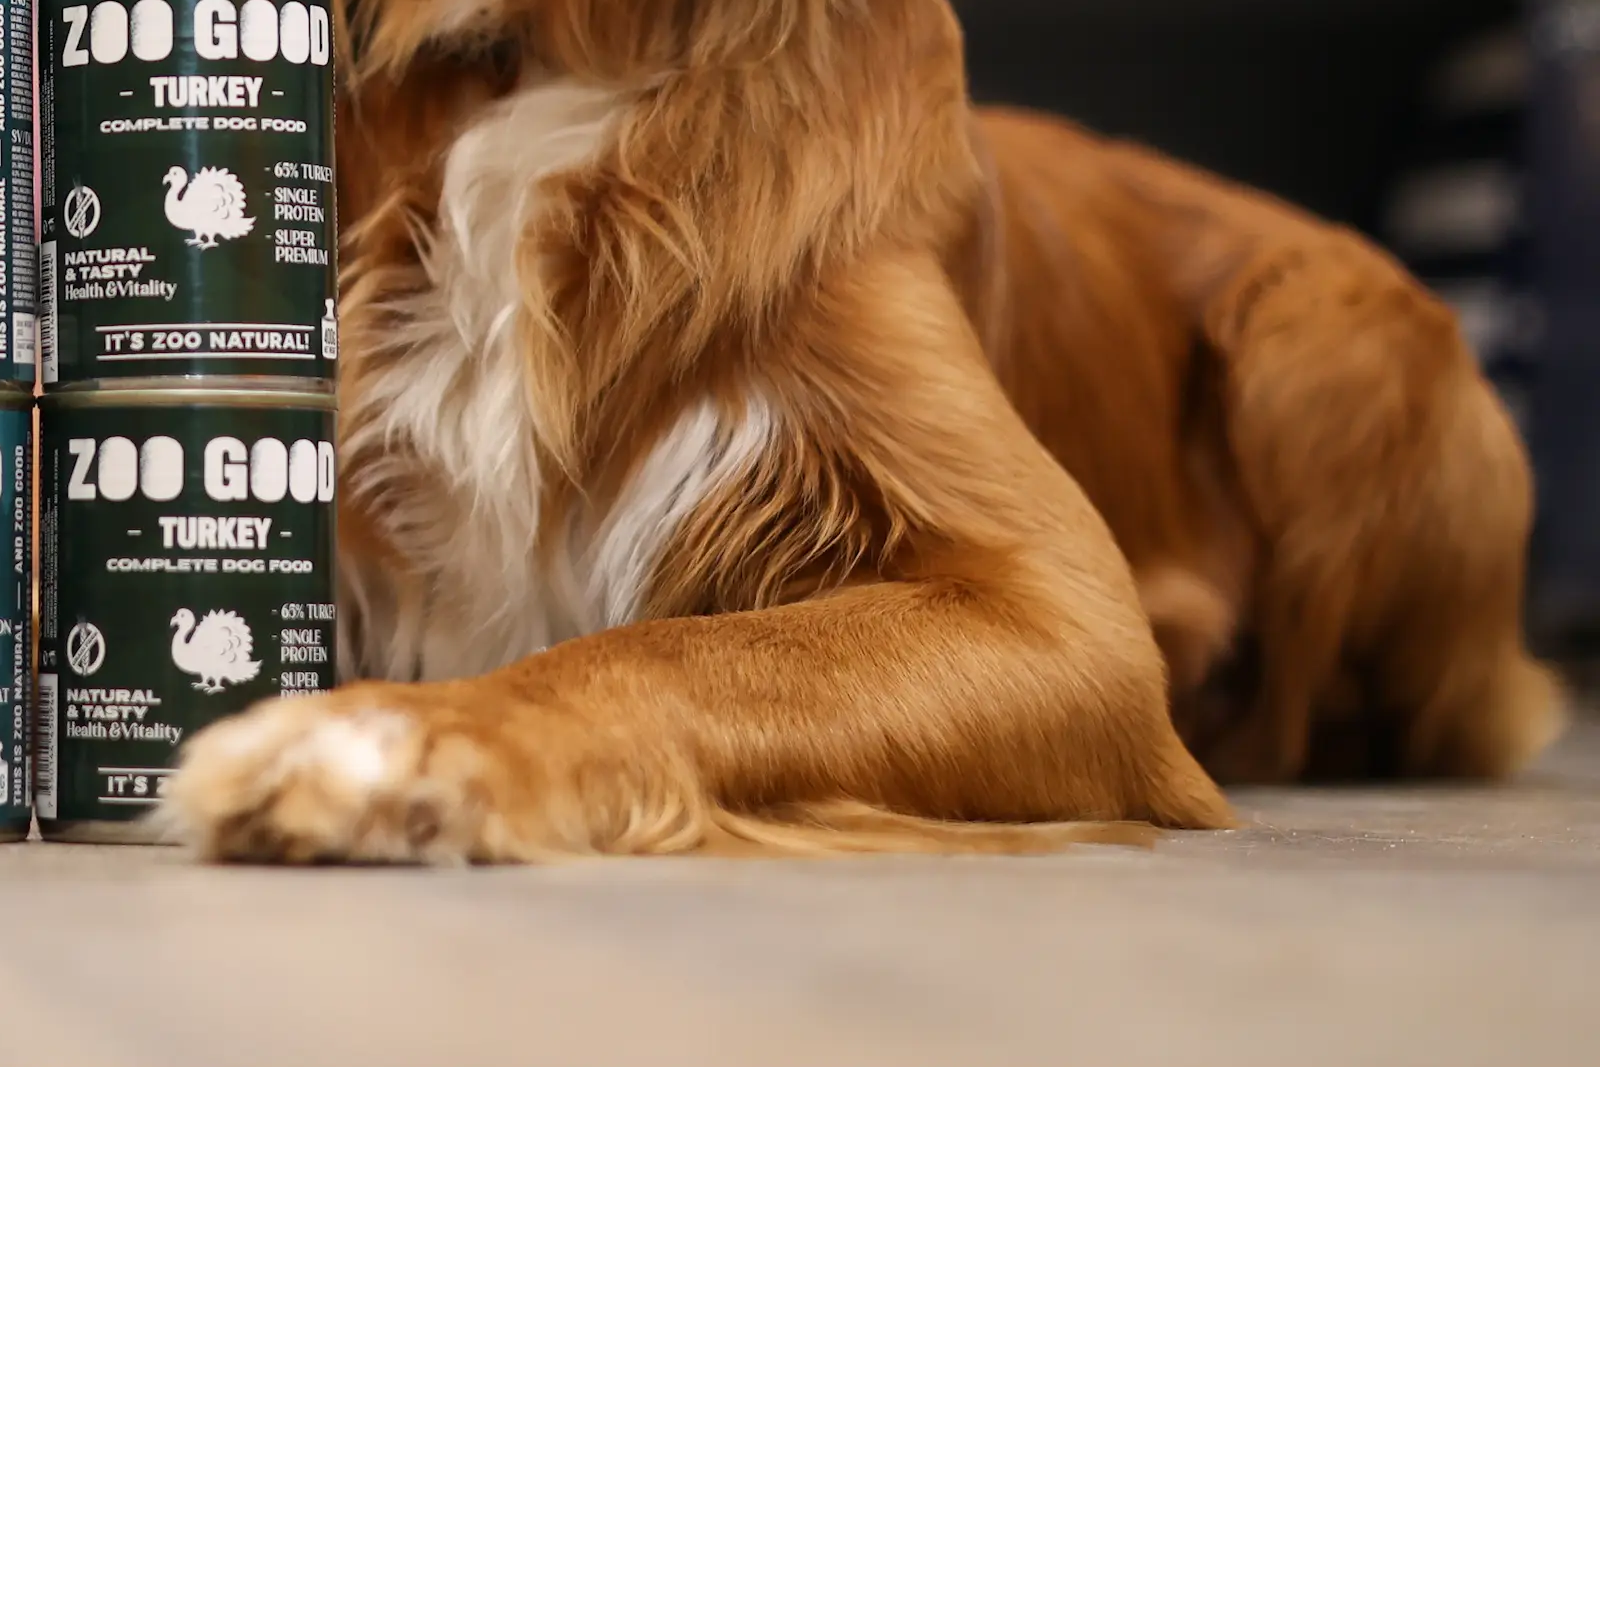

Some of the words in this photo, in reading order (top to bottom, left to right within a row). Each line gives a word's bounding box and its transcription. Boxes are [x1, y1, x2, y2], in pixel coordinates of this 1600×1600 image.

[150, 76, 263, 108] TURKEY
[101, 117, 209, 133] COMPLETE
[213, 117, 257, 130] DOG
[261, 120, 306, 132] FOOD
[275, 188, 317, 205] SINGLE
[275, 230, 315, 247] SUPER
[65, 248, 156, 264] NATURAL
[275, 247, 328, 265] PREMIUM
[105, 332, 144, 350] IT'S
[152, 332, 202, 349] ZOO
[209, 332, 310, 350] NATURAL!
[68, 436, 184, 500] ZOO
[204, 436, 334, 503] GOOD
[159, 517, 271, 548] TURKEY
[107, 558, 217, 572] COMPLETE
[222, 559, 266, 572] DOG
[269, 560, 312, 572] FOOD
[281, 629, 321, 645] SINGLE
[281, 672, 319, 688] SUPER
[66, 689, 161, 703] NATURAL
[107, 774, 147, 794] IT'S
